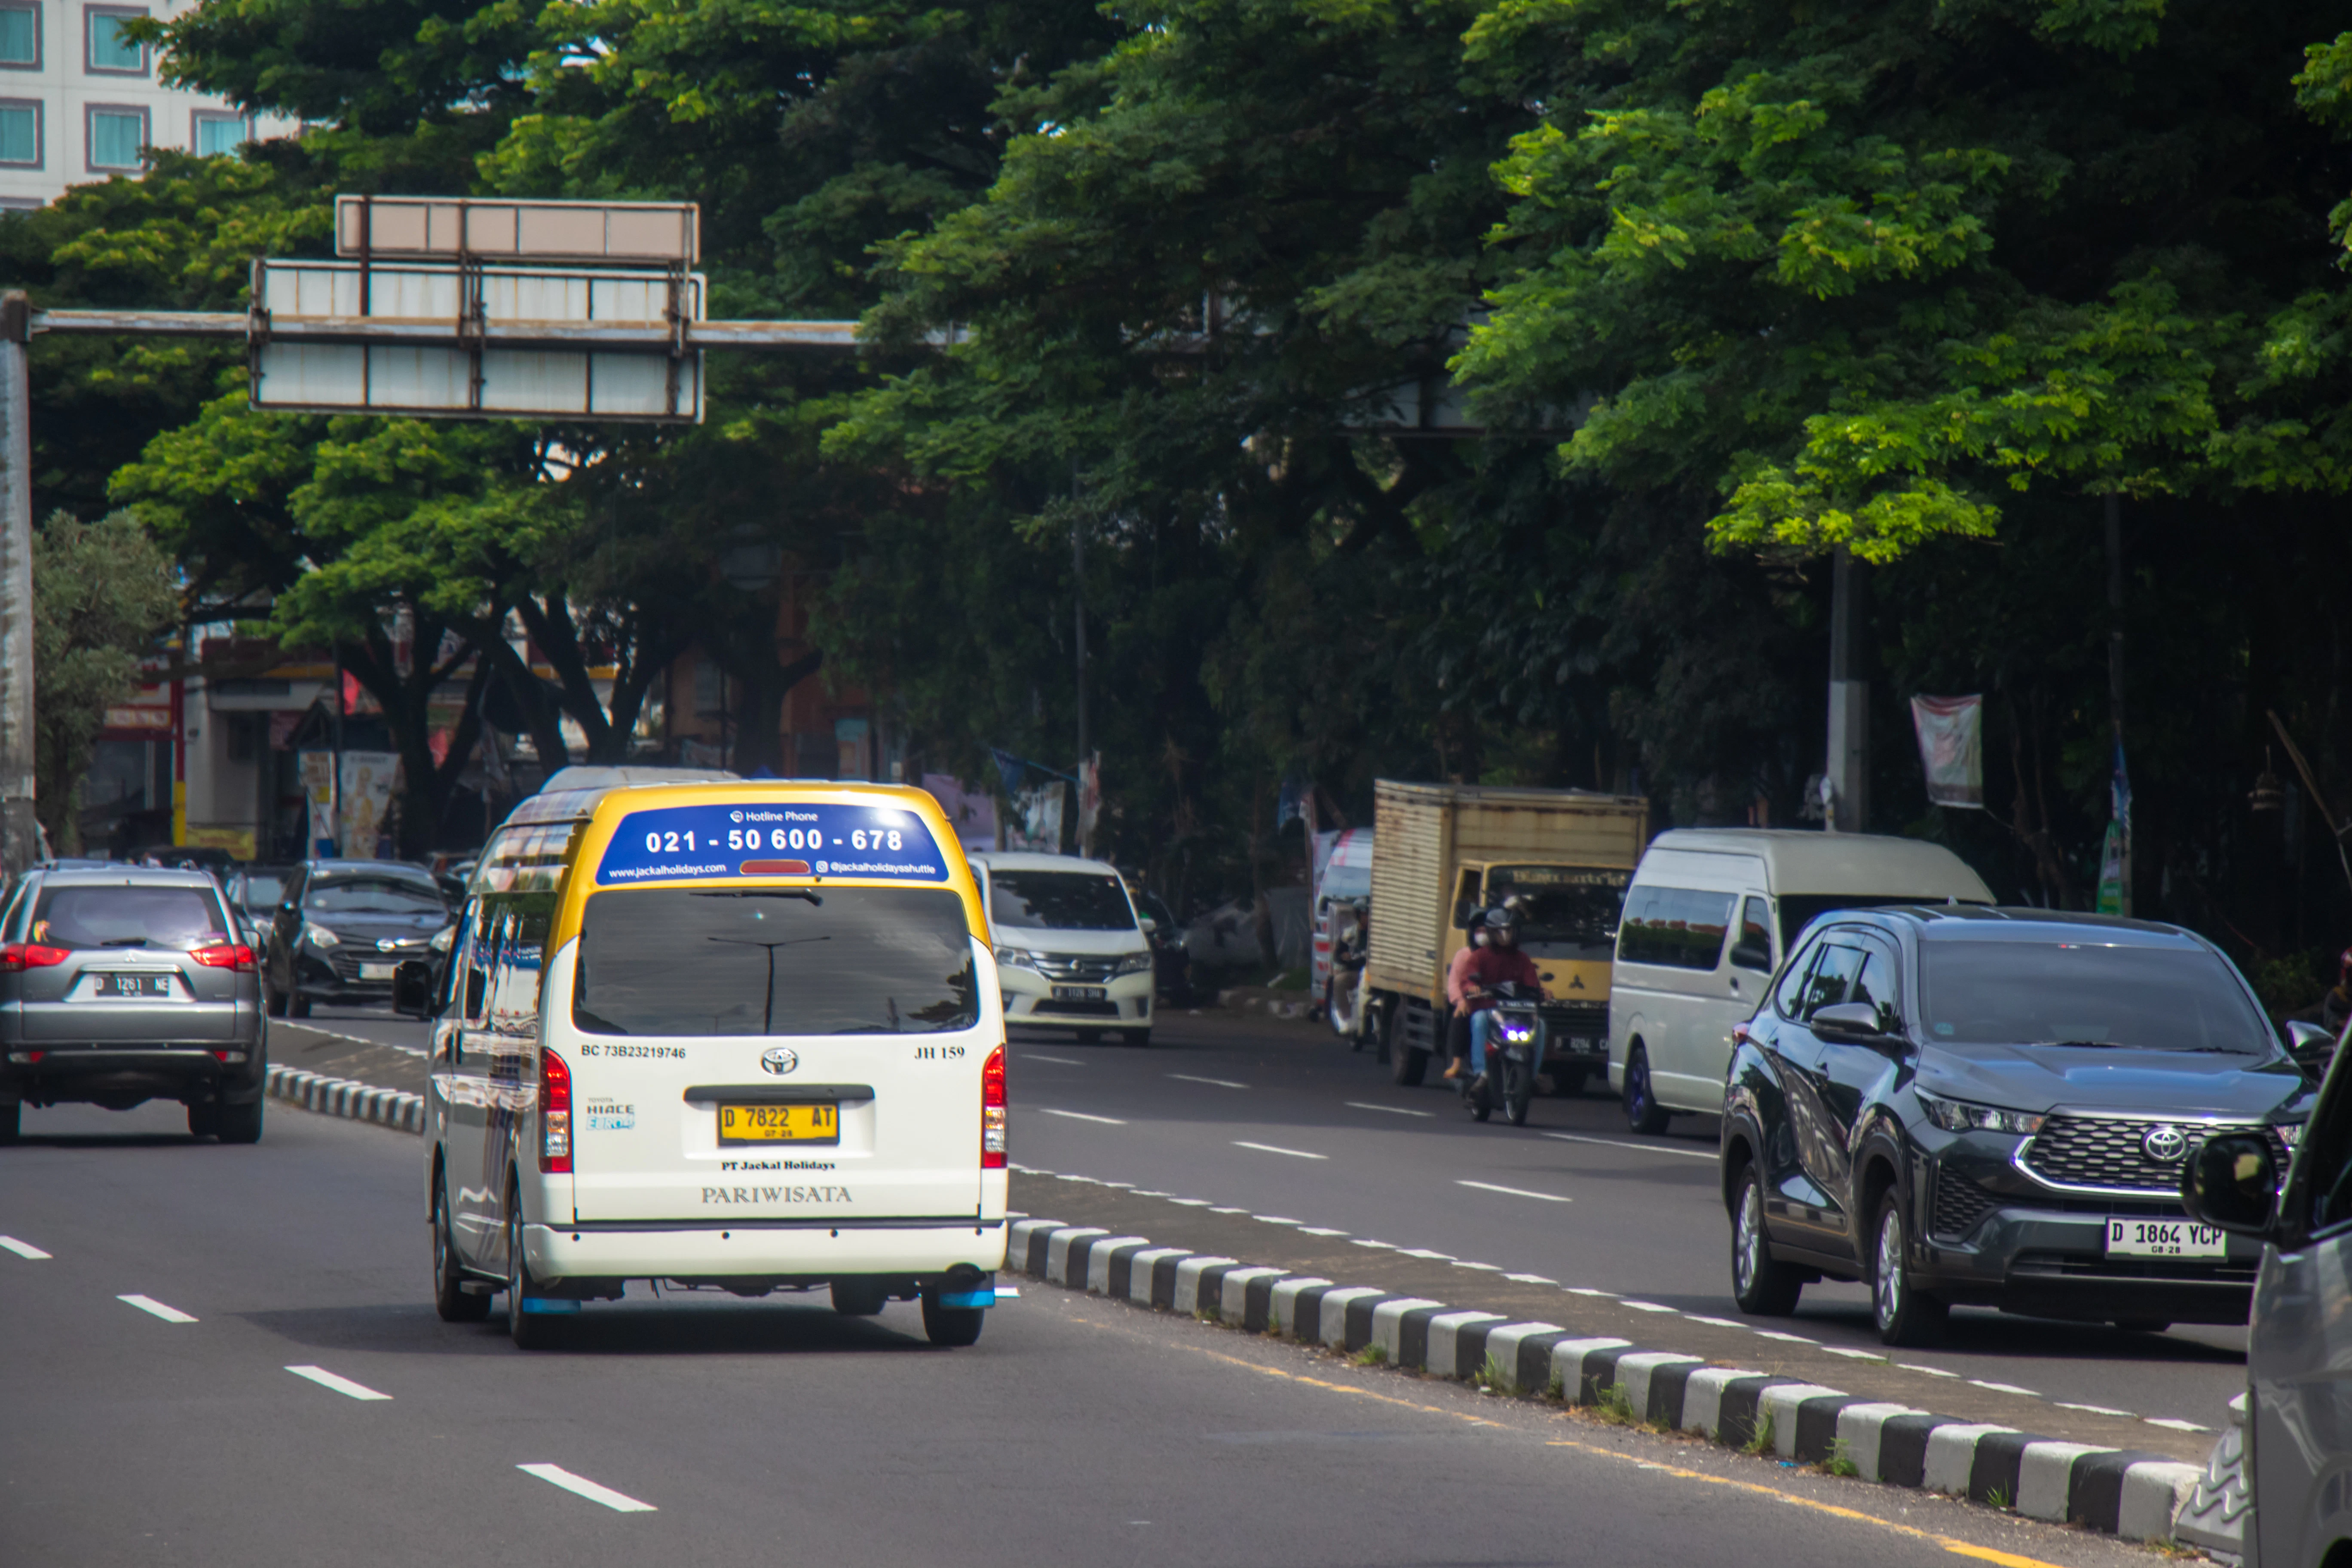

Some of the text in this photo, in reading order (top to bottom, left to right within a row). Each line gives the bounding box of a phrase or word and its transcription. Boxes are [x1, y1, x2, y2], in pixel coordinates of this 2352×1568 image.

[746, 811, 783, 821] Hotline
[784, 811, 818, 821] Phone
[646, 831, 695, 852] 021
[728, 829, 760, 850] 50
[771, 829, 822, 850] 600
[851, 830, 902, 851] 678
[609, 864, 726, 878] www.jackalholidays.com
[830, 861, 936, 875] @jackalholidaysshuttle
[95, 977, 168, 991] D 1261 NE
[581, 1045, 686, 1059] BC 73B23219746
[914, 1046, 965, 1059] JH 159
[586, 1105, 634, 1114] HIACE
[725, 1108, 832, 1127] D 7822 AT
[722, 1161, 835, 1170] PT Jackal Holidays
[701, 1187, 853, 1203] PARIWISATA
[2112, 1223, 2223, 1245] D 1864 YCP
